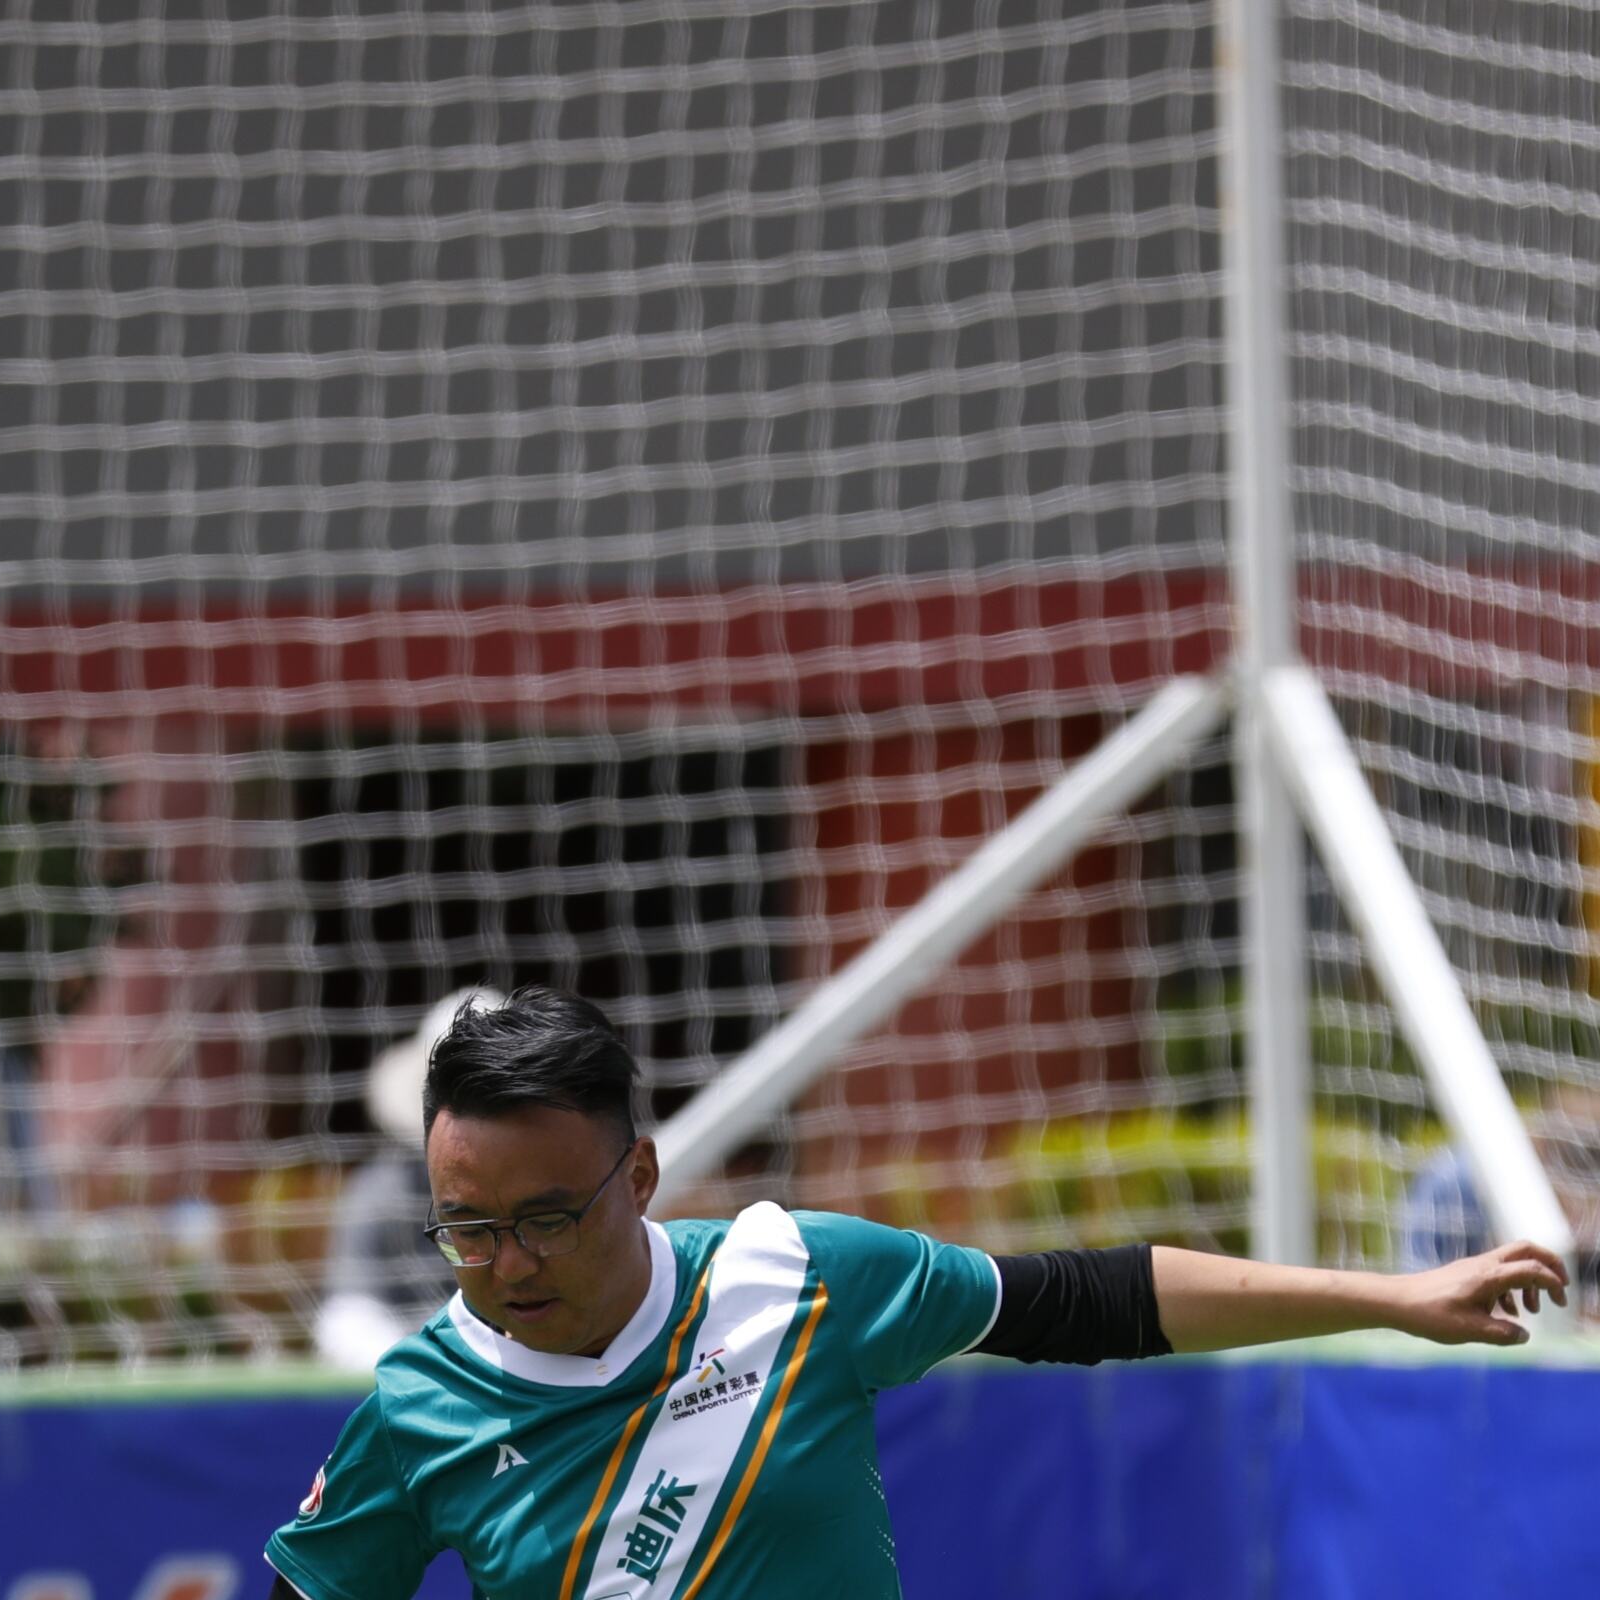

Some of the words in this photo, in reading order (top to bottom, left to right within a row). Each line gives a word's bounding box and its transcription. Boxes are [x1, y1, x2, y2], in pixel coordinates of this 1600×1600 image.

[669, 1371, 760, 1412] 中国体育彩票
[673, 1409, 697, 1421] CHINA
[697, 1399, 729, 1413] SPORTS
[729, 1386, 763, 1402] LOTTERY
[616, 1469, 699, 1586] 迪庆
